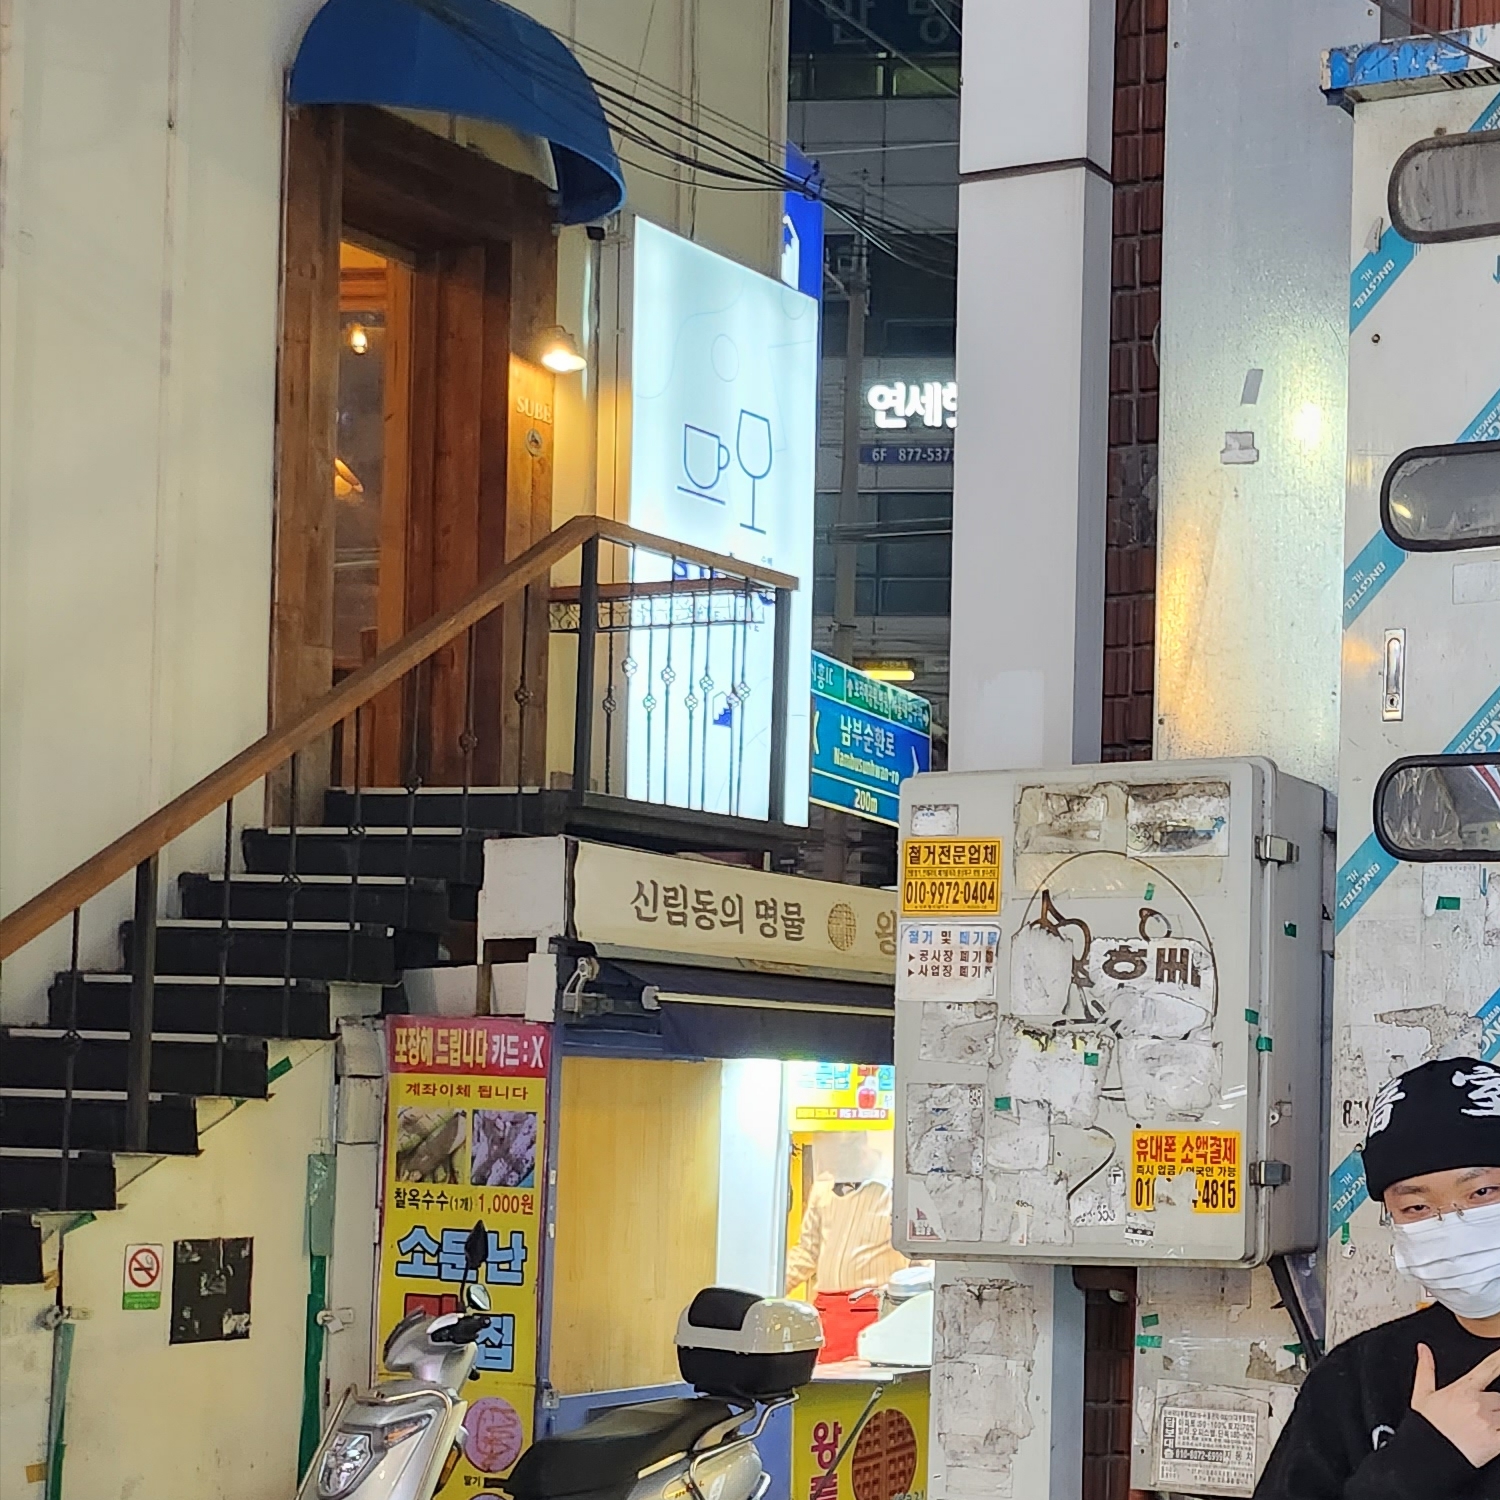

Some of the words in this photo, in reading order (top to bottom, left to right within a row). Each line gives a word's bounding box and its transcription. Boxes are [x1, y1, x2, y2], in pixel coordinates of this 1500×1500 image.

[872, 447, 887, 462] 6F
[840, 714, 896, 759] 남부순환로
[853, 788, 878, 814] 200m
[908, 844, 997, 866] 철거전문업체
[629, 879, 745, 935] 신림동의
[754, 896, 806, 942] 명물
[908, 930, 933, 945] 철거
[940, 930, 952, 945] 및
[919, 949, 954, 963] 공사장
[917, 964, 953, 978] 사업장
[394, 1026, 434, 1067] 포장해
[435, 1028, 489, 1069] 드립니다
[405, 1082, 472, 1098] 계좌이체
[1135, 1135, 1177, 1163] 휴대폰
[1180, 1135, 1237, 1165] 소액결제
[1136, 1164, 1155, 1176] 즉시
[1217, 1167, 1237, 1178] 가능
[477, 1193, 535, 1216] 1,000원
